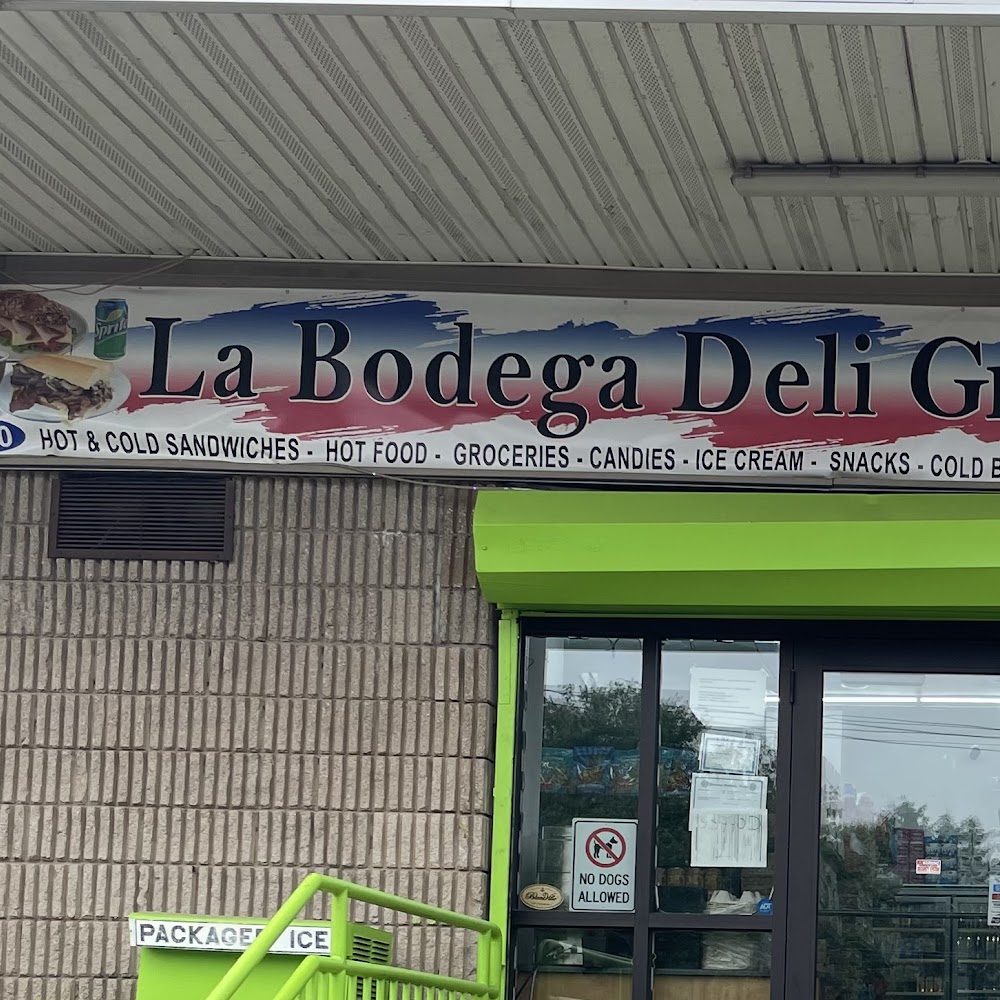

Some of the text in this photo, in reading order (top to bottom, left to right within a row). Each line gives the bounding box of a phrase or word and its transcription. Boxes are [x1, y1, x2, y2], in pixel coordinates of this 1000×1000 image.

[139, 317, 259, 399] La
[289, 319, 645, 439] Bodega
[671, 331, 878, 418] Deli
[40, 429, 78, 451] HOT
[87, 431, 100, 453] &
[105, 431, 160, 455] COLD
[165, 433, 299, 461] SANDWICHES
[326, 440, 366, 463] HOT
[373, 441, 427, 464] FOOD
[454, 443, 569, 468] GROCERIES
[589, 446, 676, 471] CANDIES
[696, 449, 727, 471] ICE
[734, 450, 804, 471] CREAM
[829, 451, 910, 475] SNACKS
[930, 454, 984, 479] COLD
[579, 872, 630, 886] NO DOGS
[578, 890, 630, 904] ALLOWED
[139, 923, 330, 950] PACKAGE ICE
